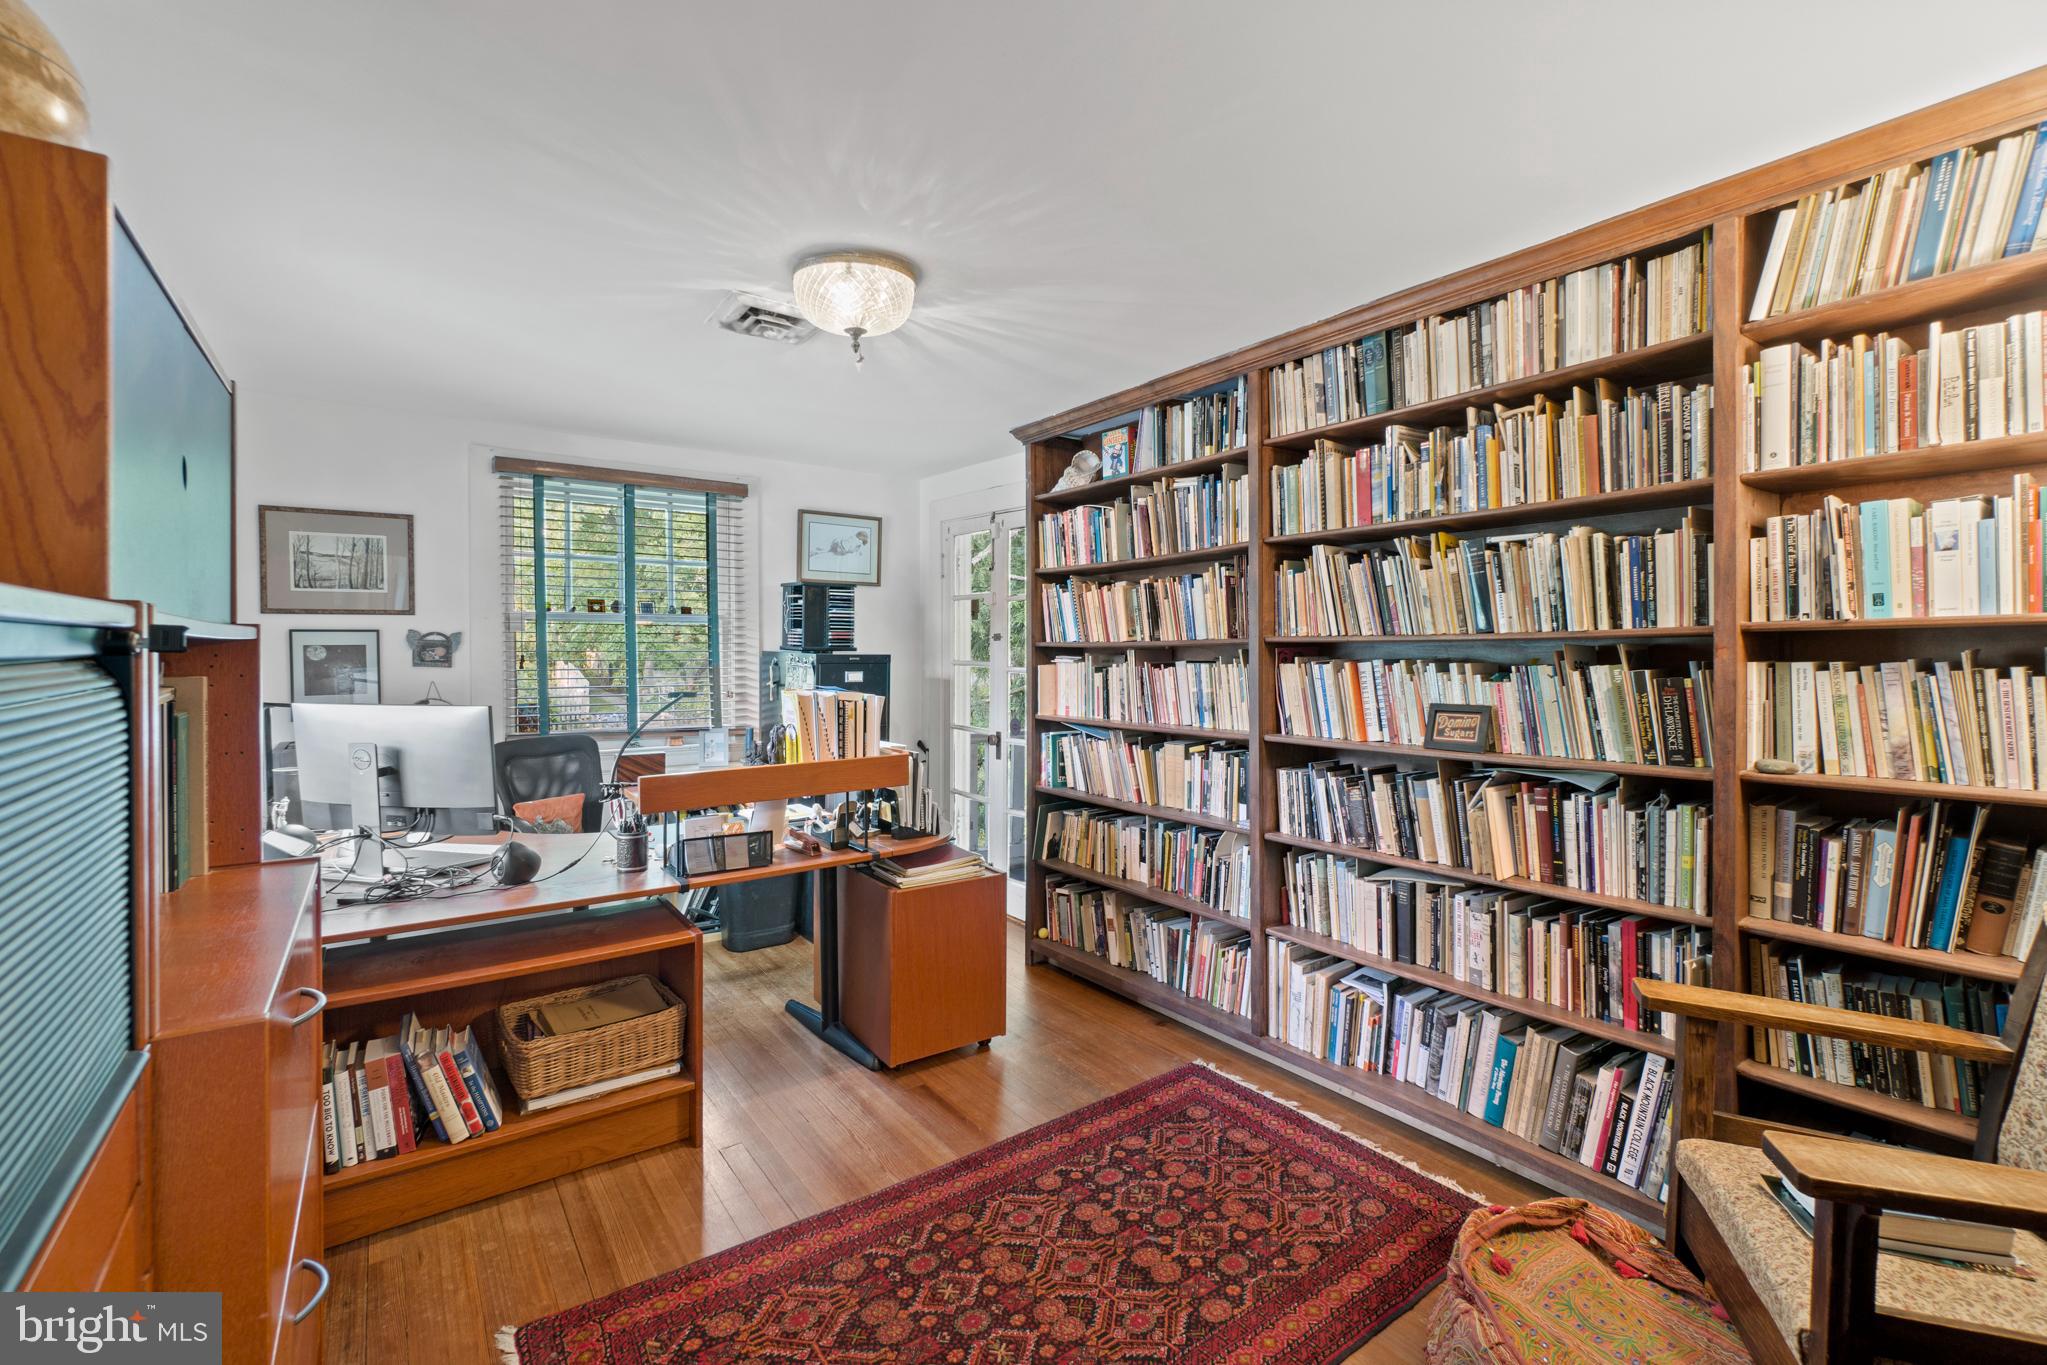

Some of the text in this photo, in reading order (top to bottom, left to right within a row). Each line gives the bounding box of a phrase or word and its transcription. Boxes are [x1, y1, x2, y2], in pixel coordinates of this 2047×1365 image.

[1360, 671, 1373, 728] KENNETH KOCH
[1438, 716, 1478, 729] Domino
[1443, 727, 1475, 740] Sugars
[1628, 1068, 1657, 1162] BLACK MOUNTAIN COLLEGE
[325, 1122, 332, 1132] TO
[1610, 1102, 1628, 1161] BLACK MOUNTAIN DAYS
[326, 1134, 335, 1156] KNOW
